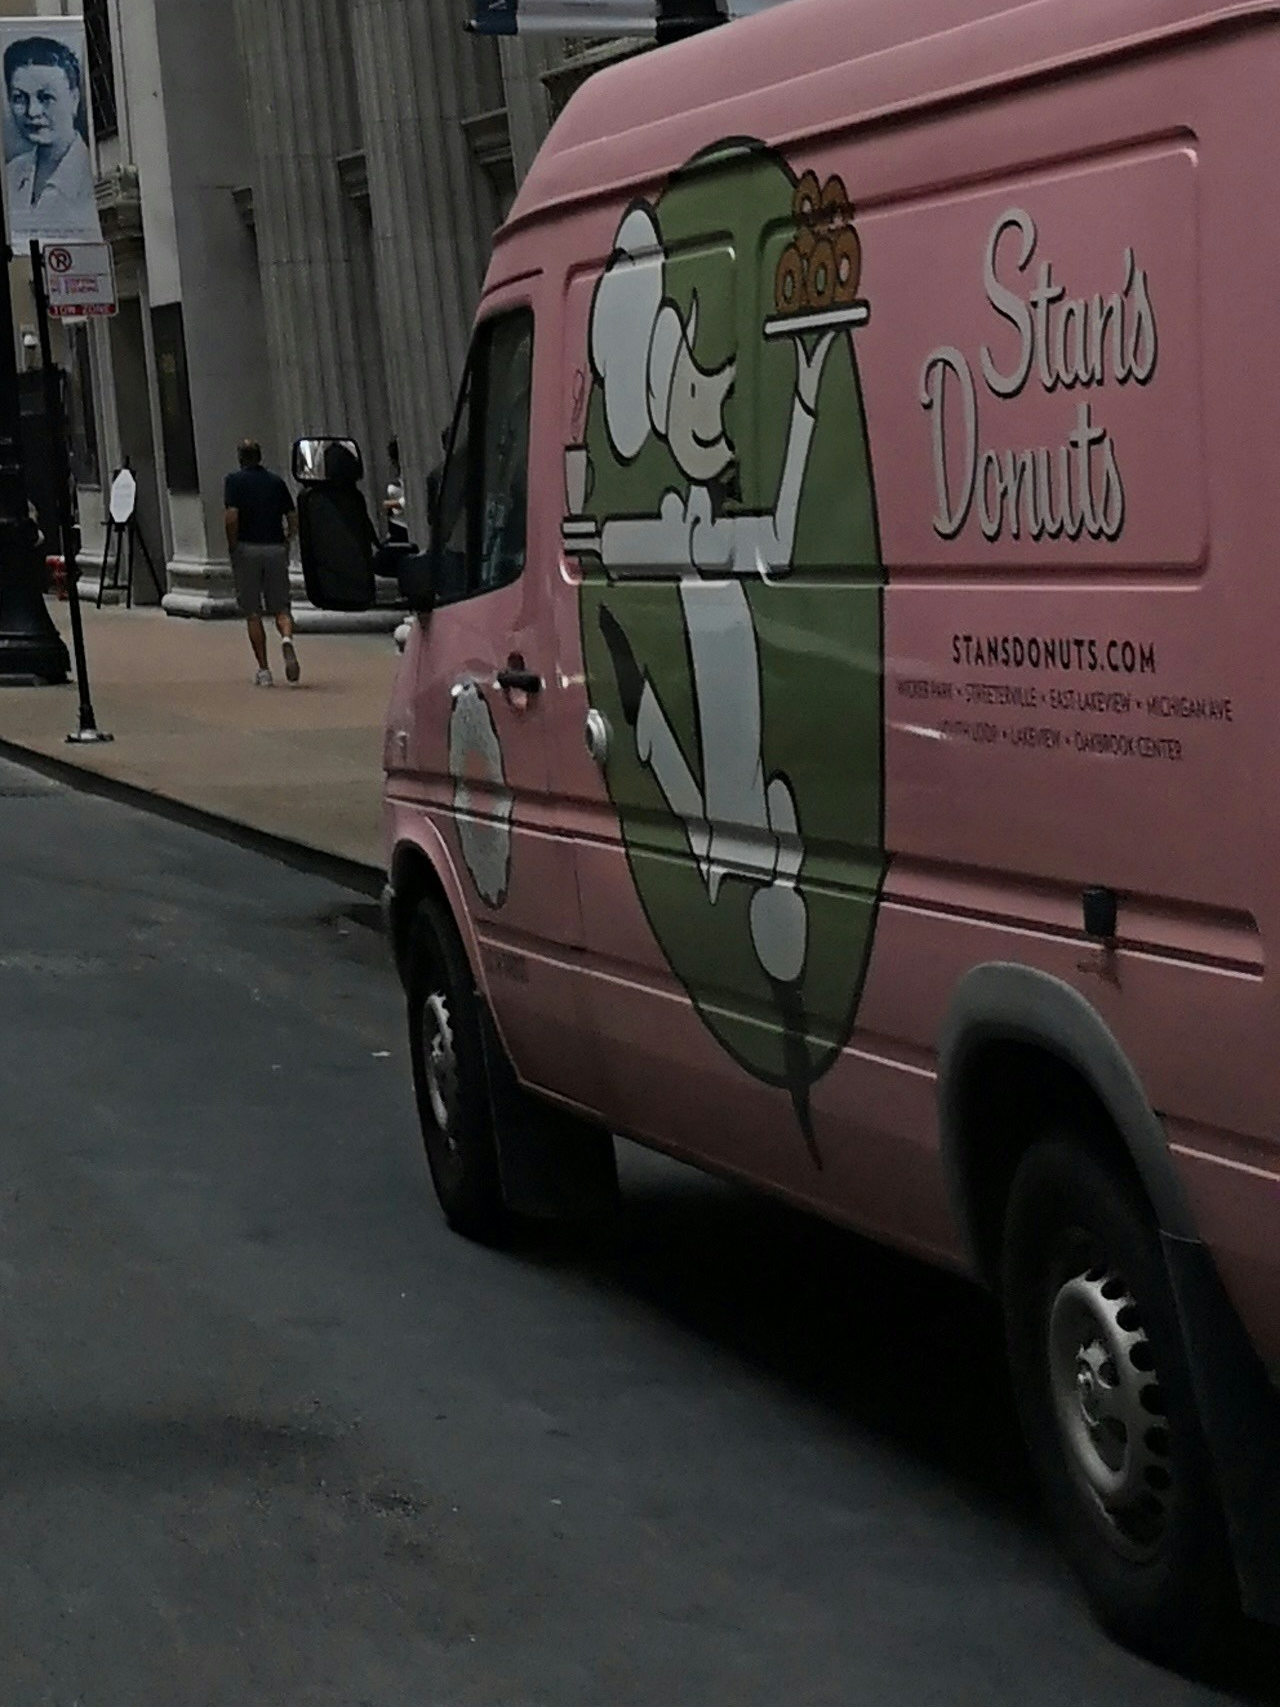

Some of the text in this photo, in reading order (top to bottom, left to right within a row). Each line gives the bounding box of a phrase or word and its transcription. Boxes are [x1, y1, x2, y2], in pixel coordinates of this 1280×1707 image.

[982, 206, 1158, 400] Stan's
[920, 345, 1126, 542] Donuts
[952, 634, 1157, 674] STANSDONUTS.COM
